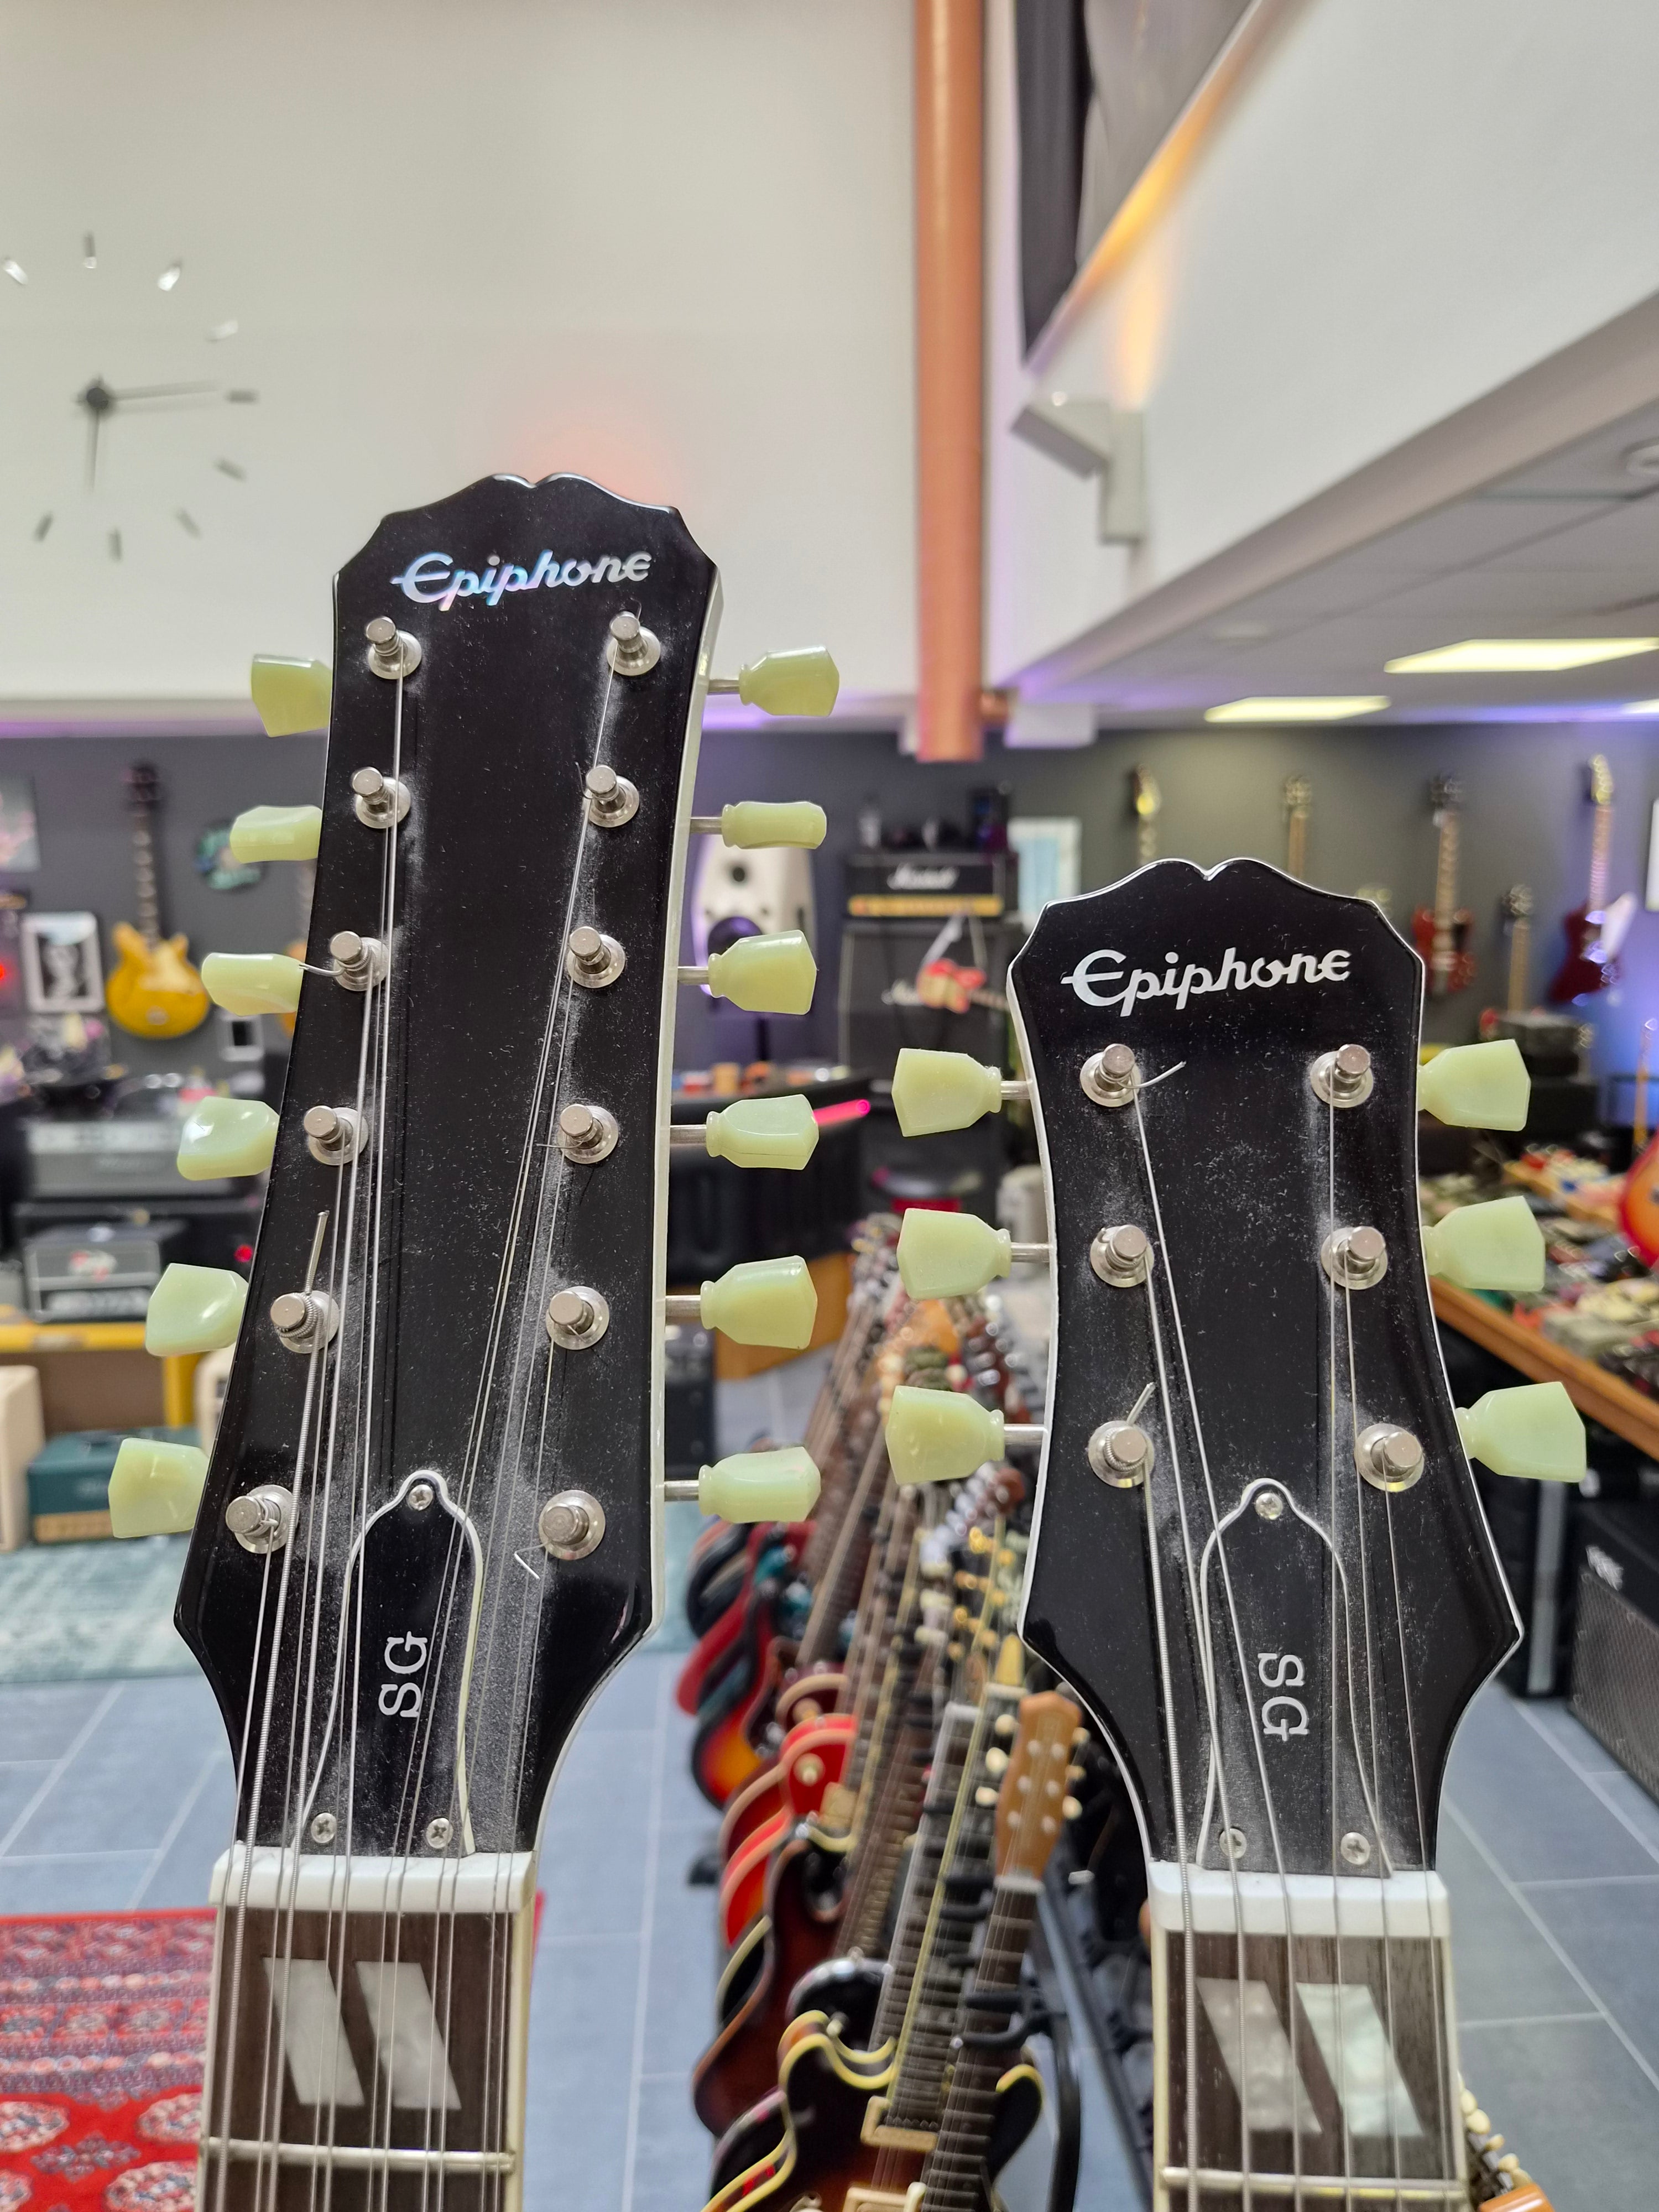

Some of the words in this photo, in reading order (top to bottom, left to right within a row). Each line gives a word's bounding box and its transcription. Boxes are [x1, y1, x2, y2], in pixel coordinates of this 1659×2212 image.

[390, 549, 652, 611] Epiphone
[1061, 947, 1352, 1016] Epiphone
[378, 1631, 427, 1717] SG
[1258, 1653, 1310, 1741] SG
